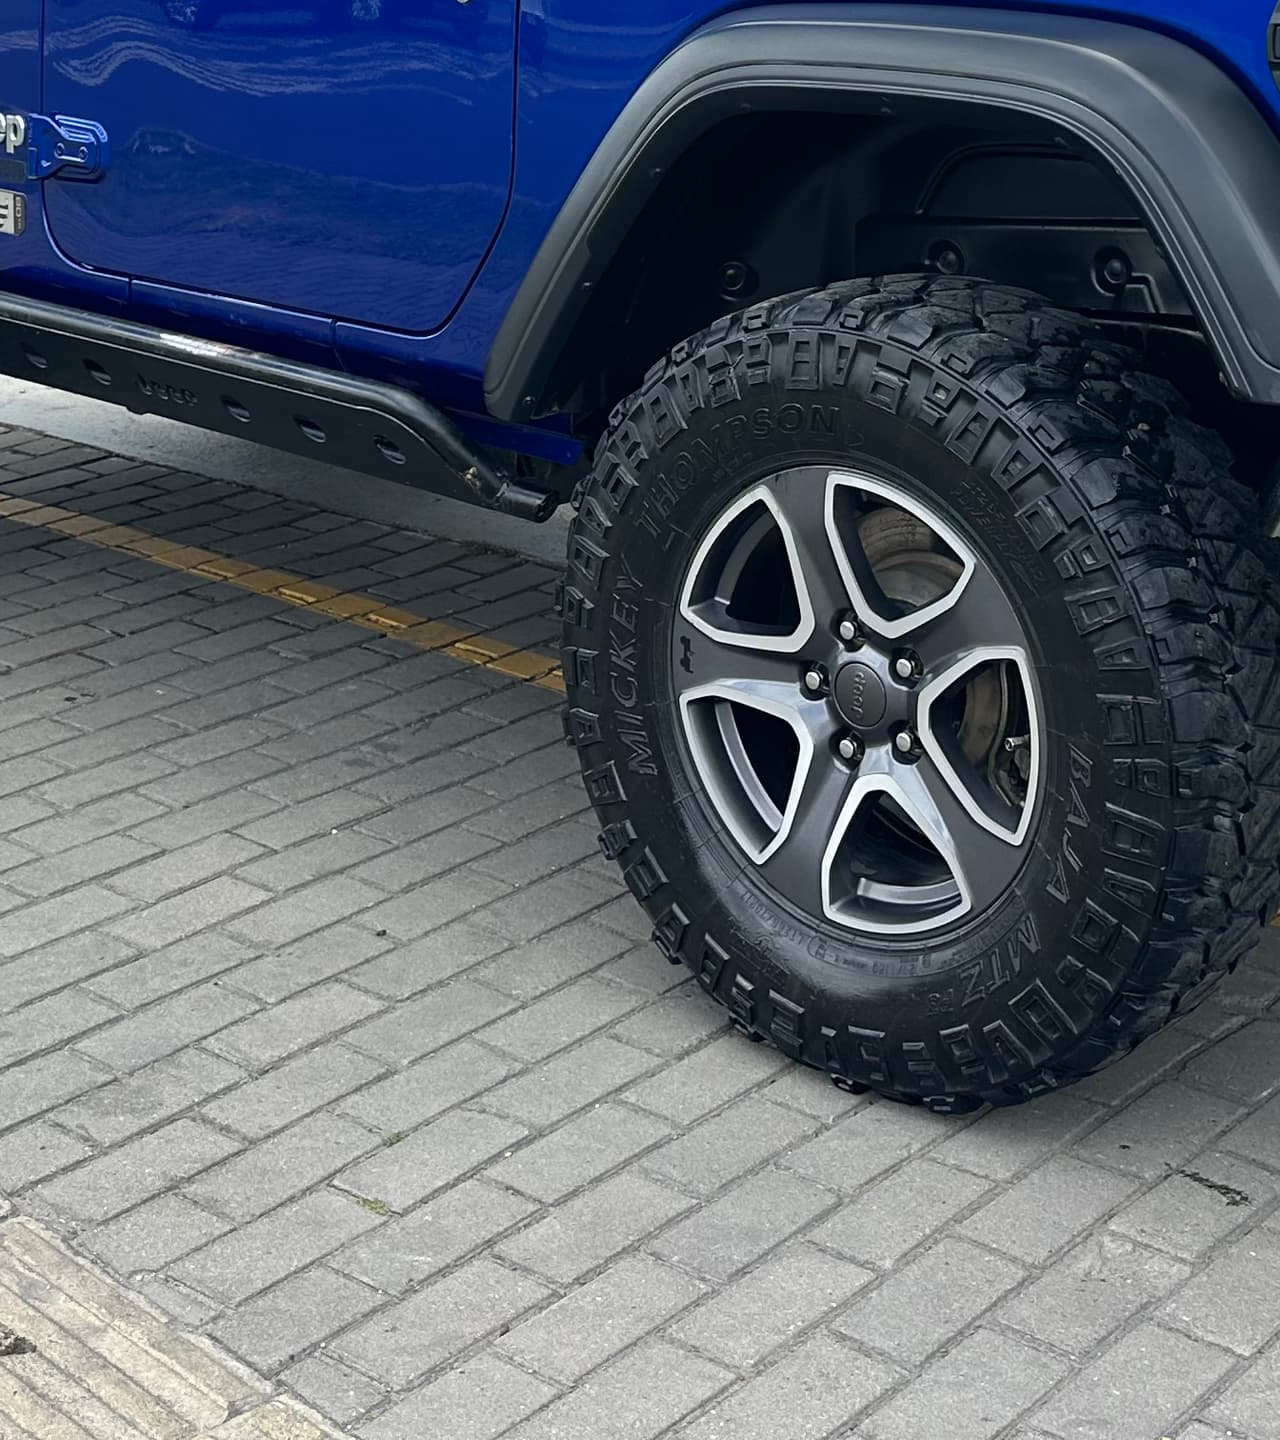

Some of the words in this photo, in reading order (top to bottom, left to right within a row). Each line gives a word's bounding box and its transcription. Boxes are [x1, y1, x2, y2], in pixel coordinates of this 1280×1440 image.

[634, 403, 840, 537] THOMPSON
[608, 553, 658, 776] MICKEY
[1046, 742, 1094, 903] BAJA
[959, 912, 1042, 1007] MTZ
